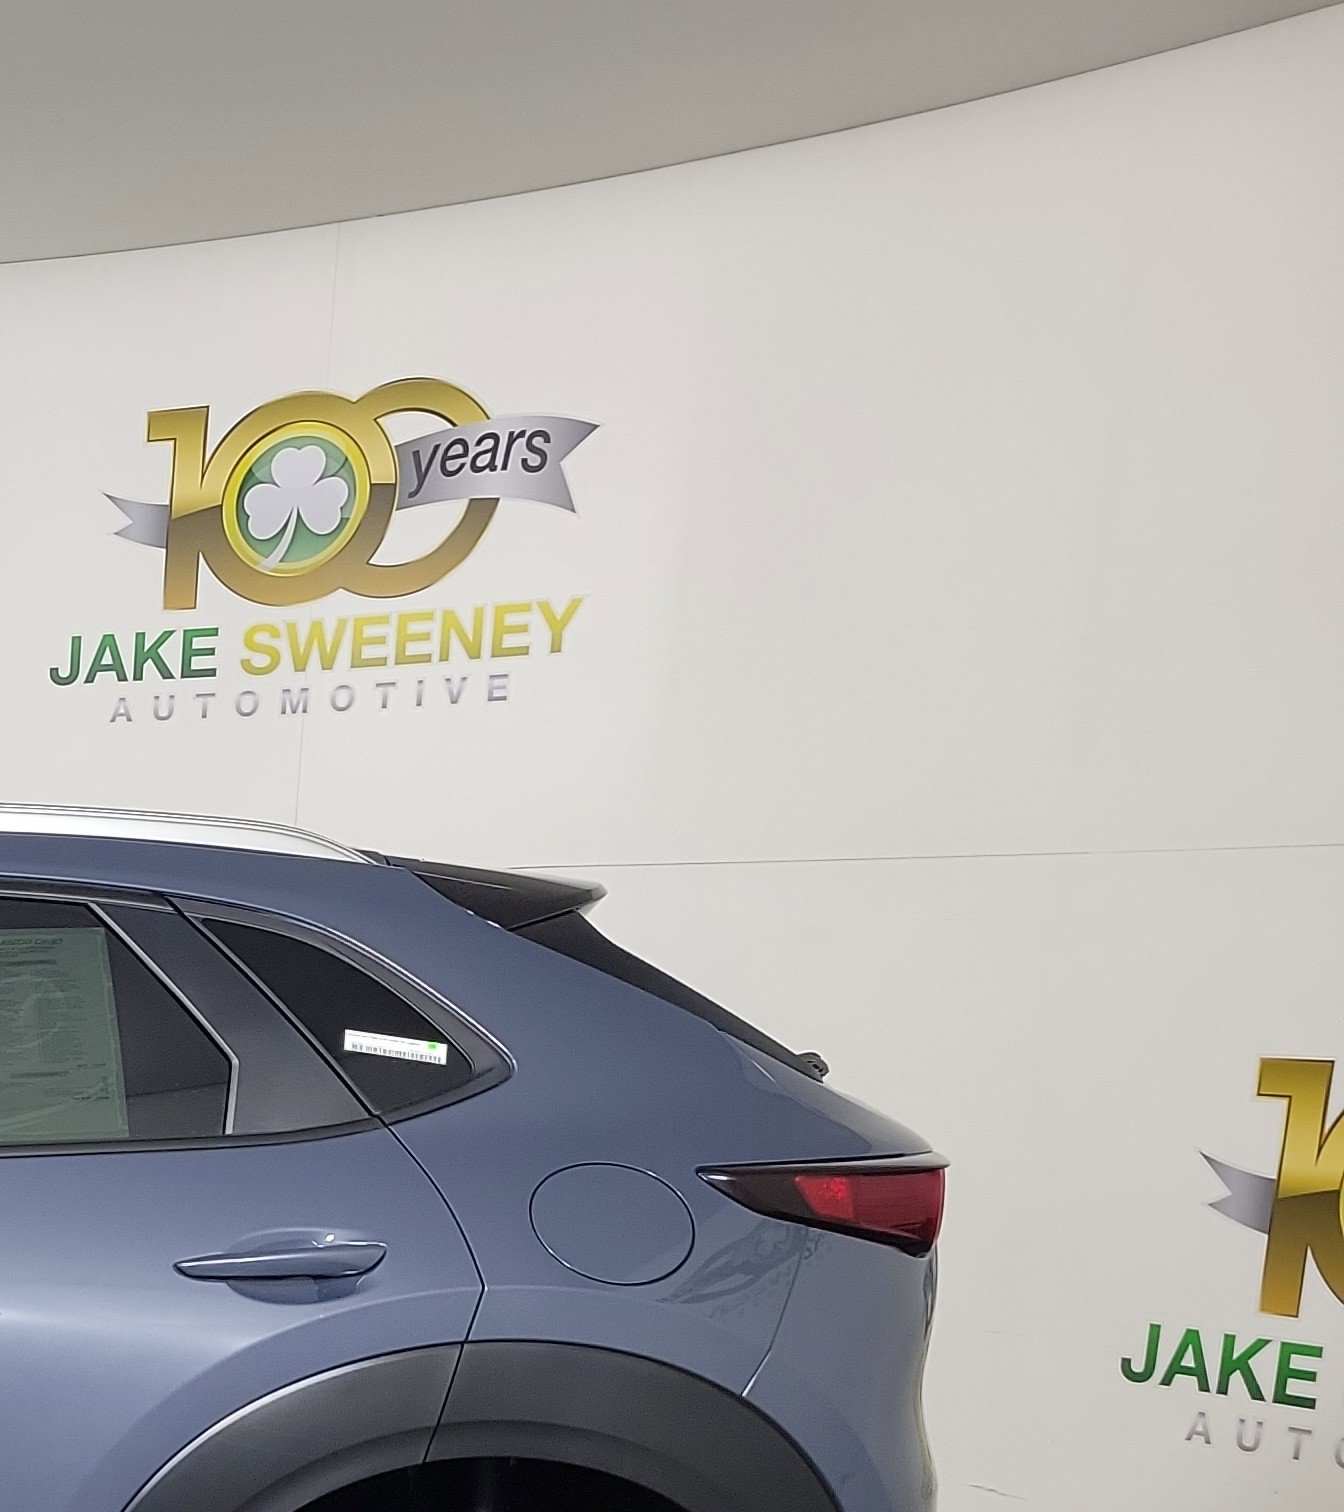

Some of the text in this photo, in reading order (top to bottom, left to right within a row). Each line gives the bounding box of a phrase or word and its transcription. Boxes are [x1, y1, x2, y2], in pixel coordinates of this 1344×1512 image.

[146, 377, 551, 610] 100 years
[49, 596, 584, 686] JAKE SWEENEY
[110, 673, 509, 723] AUTOMOTIVE
[1120, 1322, 1324, 1410] JAKE
